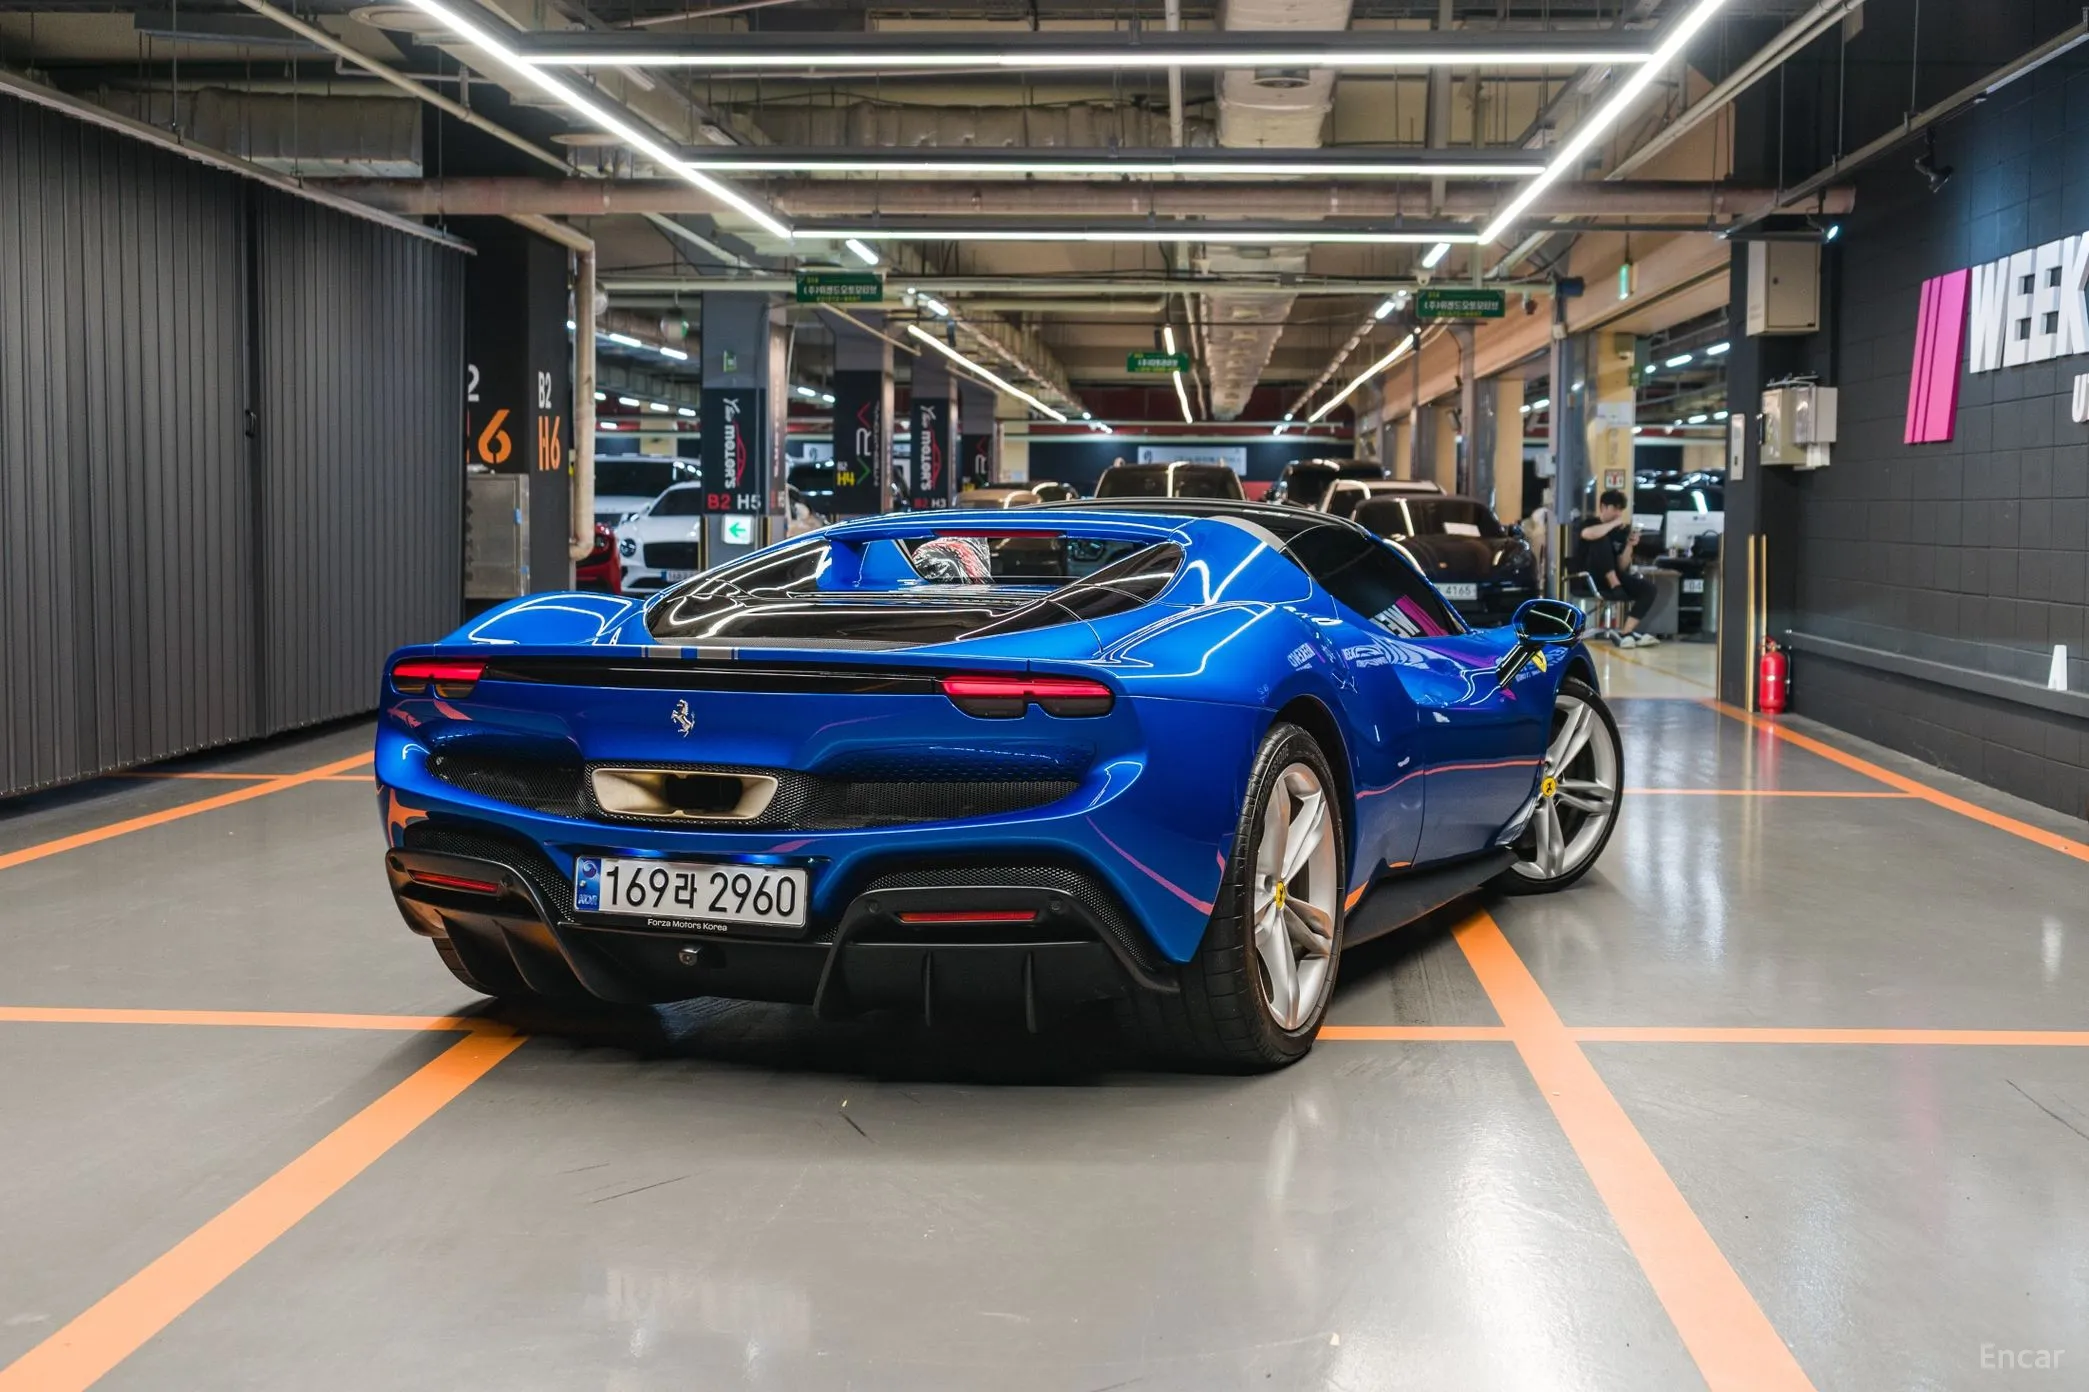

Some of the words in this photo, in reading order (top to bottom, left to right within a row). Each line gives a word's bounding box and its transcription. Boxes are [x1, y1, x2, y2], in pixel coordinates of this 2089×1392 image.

[1970, 231, 2089, 373] WEEK
[538, 370, 552, 409] B2
[2071, 372, 2089, 423] U
[467, 408, 512, 464] 6
[538, 415, 561, 471] H6
[707, 493, 732, 510] B2
[736, 493, 761, 510] H5
[606, 865, 698, 909] 169라
[708, 871, 796, 917] 2960
[647, 918, 671, 927] Forza
[672, 920, 701, 930] Motors
[702, 922, 728, 932] Korea
